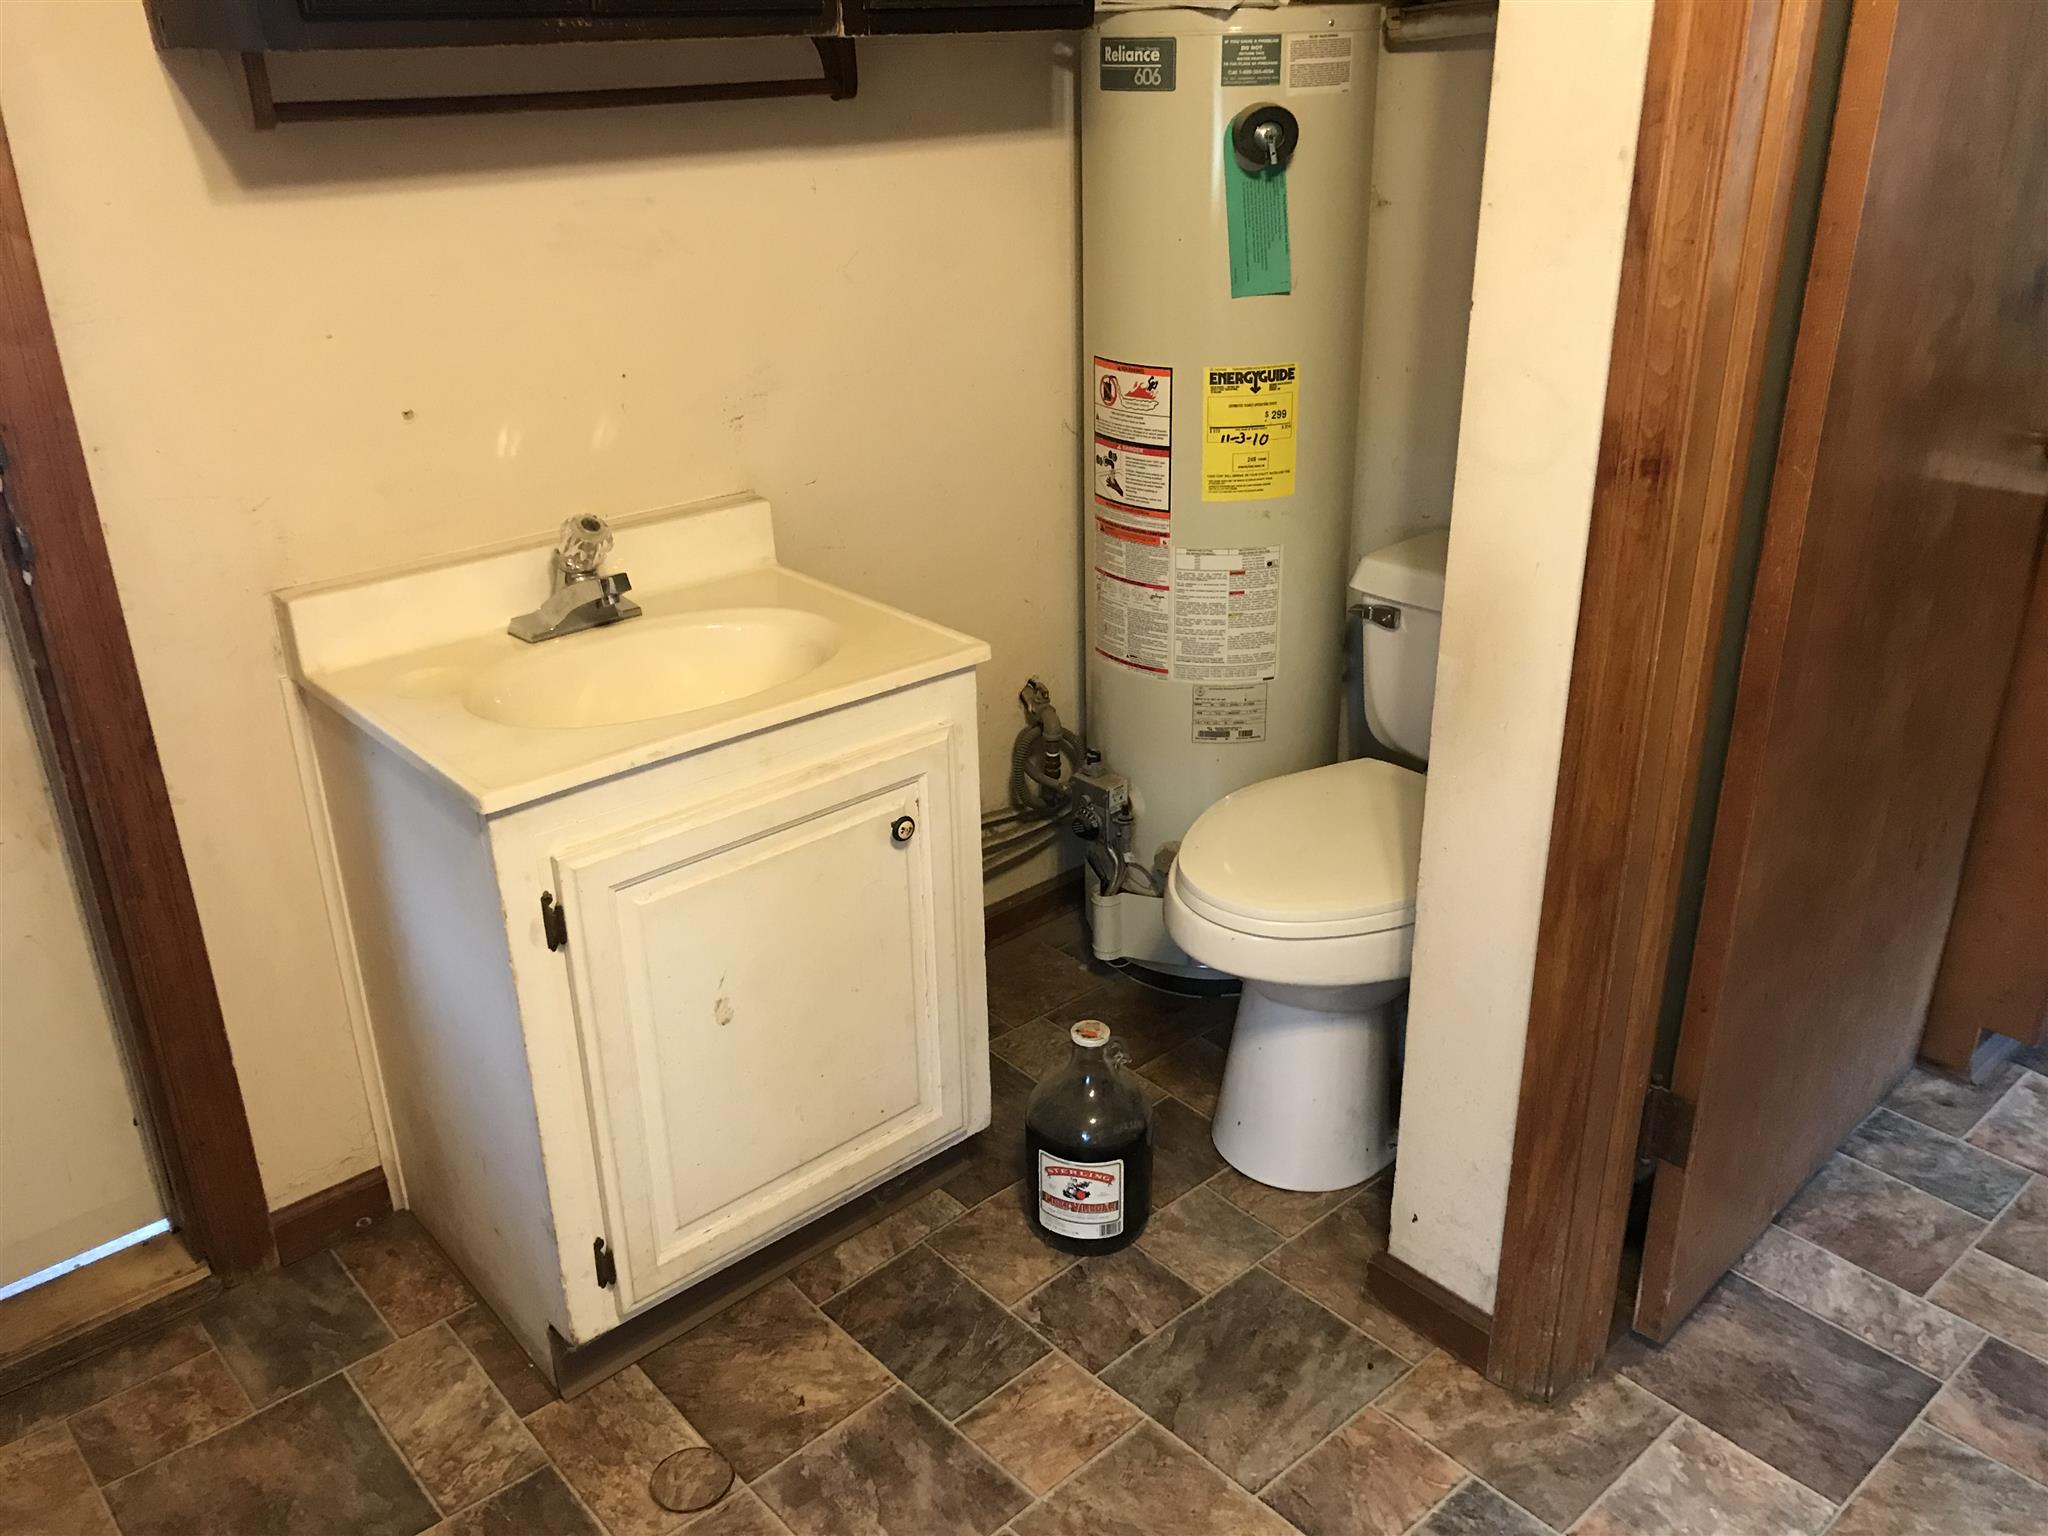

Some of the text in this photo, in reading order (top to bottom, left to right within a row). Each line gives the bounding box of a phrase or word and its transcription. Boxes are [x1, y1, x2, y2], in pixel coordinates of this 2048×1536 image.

[1104, 45, 1160, 62] Reliance
[1134, 68, 1162, 86] 606
[1209, 367, 1296, 386] ENERGYGUIDE
[1271, 409, 1287, 420] 299
[1220, 431, 1270, 446] 11-3-10
[1047, 1168, 1111, 1182] STERLING
